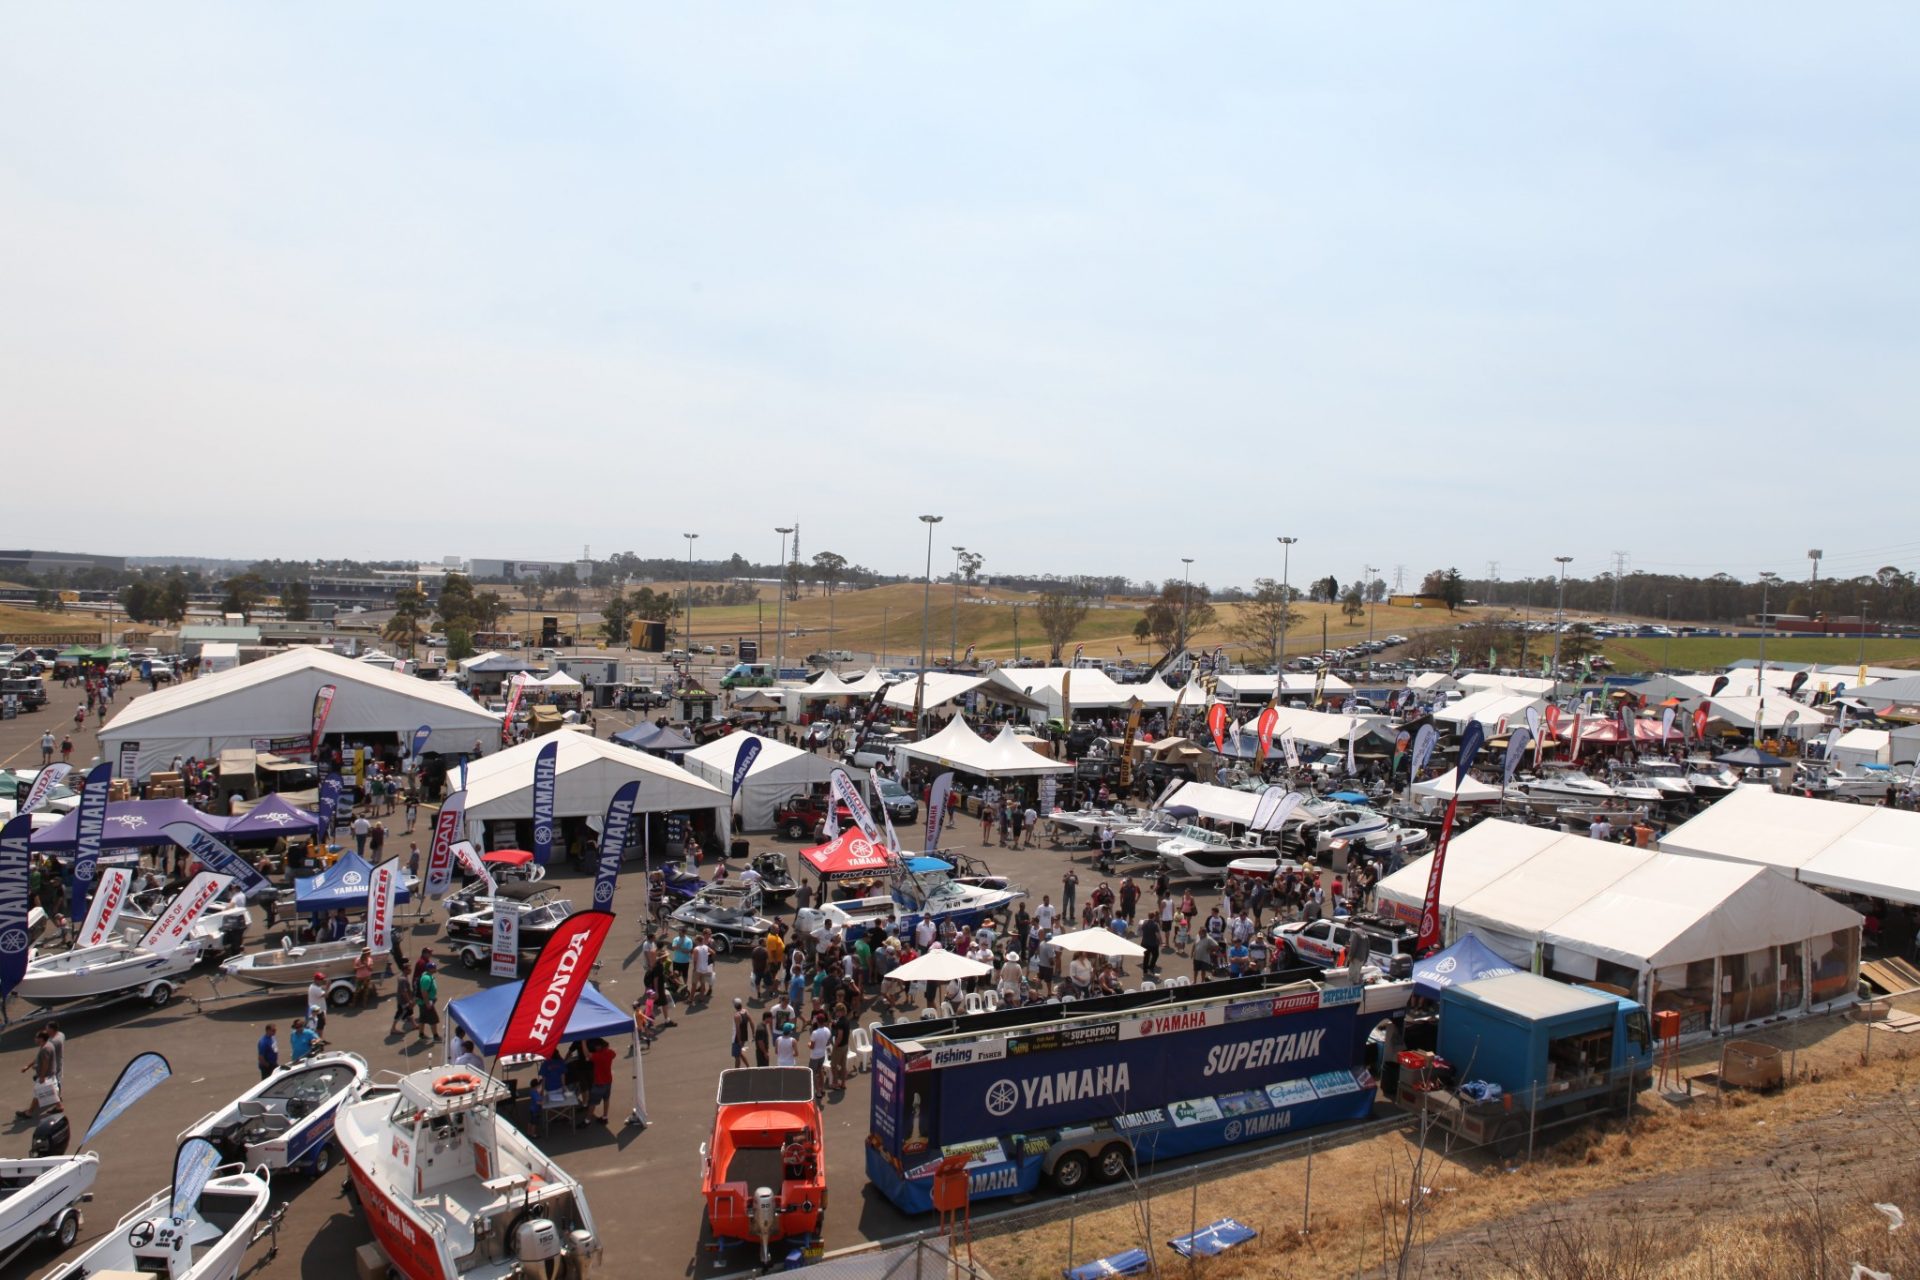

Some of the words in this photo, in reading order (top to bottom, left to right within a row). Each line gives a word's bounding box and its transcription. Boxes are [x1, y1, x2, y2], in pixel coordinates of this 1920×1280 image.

[4, 634, 98, 644] ACCREDITATION
[734, 746, 759, 783] NARVA
[1121, 760, 1130, 783] ROOF
[534, 757, 555, 824] YAMAHA
[78, 781, 108, 859] YAMAHA
[928, 805, 938, 833] YAMAHA
[187, 834, 228, 869] YMI
[433, 814, 455, 866] LOAN
[598, 800, 634, 879] YAMAHA
[848, 857, 884, 866] YAMAHA
[1424, 830, 1448, 915] YAMAHA
[1, 837, 28, 926] YAMAHA
[91, 871, 125, 946] STACER
[155, 914, 176, 937] YEARS
[173, 905, 183, 915] OF
[172, 880, 219, 937] STACER
[374, 869, 389, 946] STACER
[529, 930, 591, 1046] HONDA
[1416, 970, 1453, 986] YAMAHA
[1275, 994, 1319, 1009] ATOMIC
[1071, 1025, 1117, 1040] SUPERFROG
[1155, 1011, 1207, 1033] YAMAHA
[935, 1048, 973, 1064] fishing
[978, 1050, 1002, 1060] FISHER
[1203, 1028, 1327, 1077] SUPERTANK
[1022, 1062, 1131, 1109] YAMAHA
[1114, 1108, 1166, 1129] YAMALUBE
[1244, 1110, 1292, 1136] YAMAHA
[968, 1167, 1019, 1194] AMAHA
[540, 1234, 554, 1244] 150
